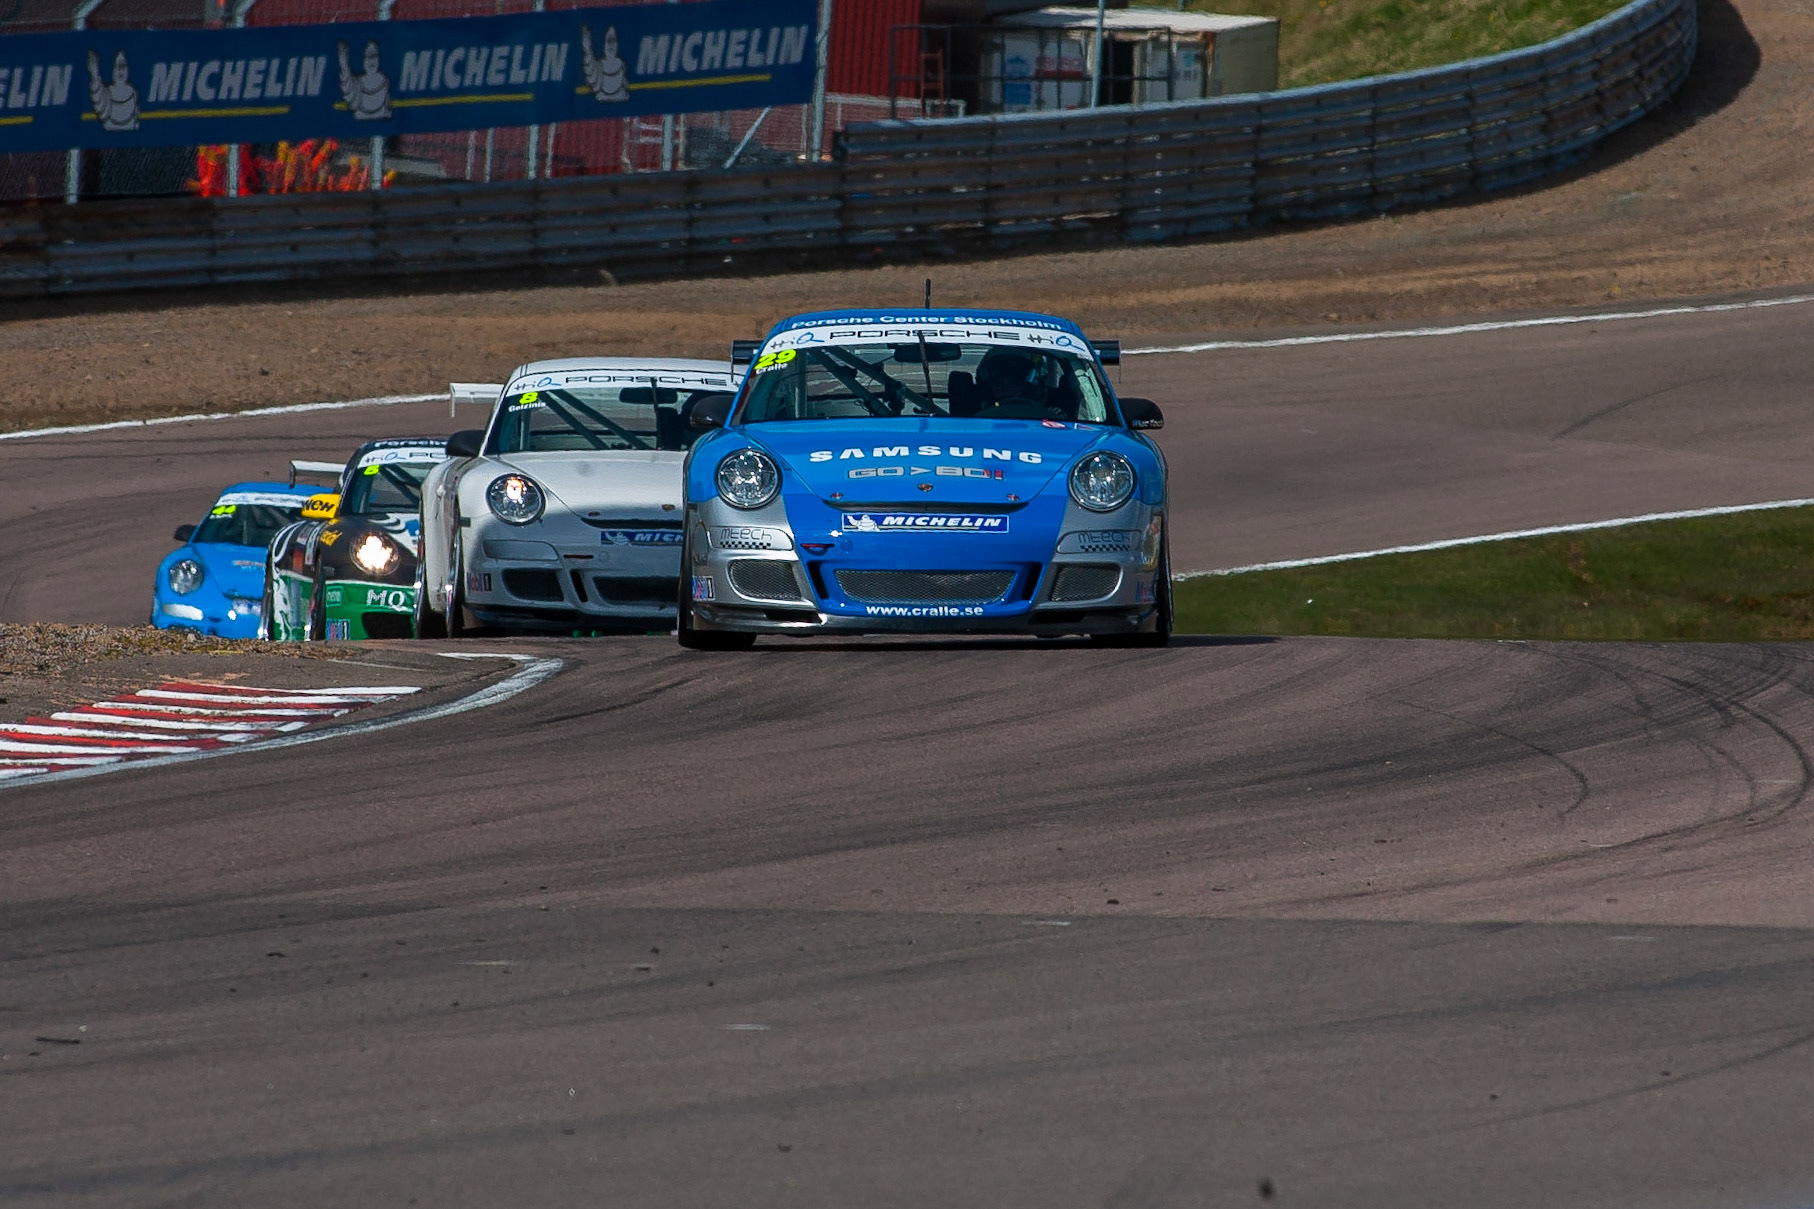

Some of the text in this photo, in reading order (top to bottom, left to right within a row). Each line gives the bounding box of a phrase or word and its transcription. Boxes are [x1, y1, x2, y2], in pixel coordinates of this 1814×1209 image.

[636, 25, 809, 75] MICHELIN
[399, 42, 569, 92] MICHELIN
[147, 55, 327, 103] MICHELIN
[791, 315, 1063, 331] Porsche Center Stockholm
[829, 329, 1021, 341] PORSCHE
[754, 349, 797, 371] 29
[565, 375, 728, 387] PORSCHE
[519, 391, 538, 405] 8
[809, 446, 1042, 464] SAMSUNG
[881, 515, 1002, 527] MICHELIN
[866, 605, 984, 616] www.cralle.se
